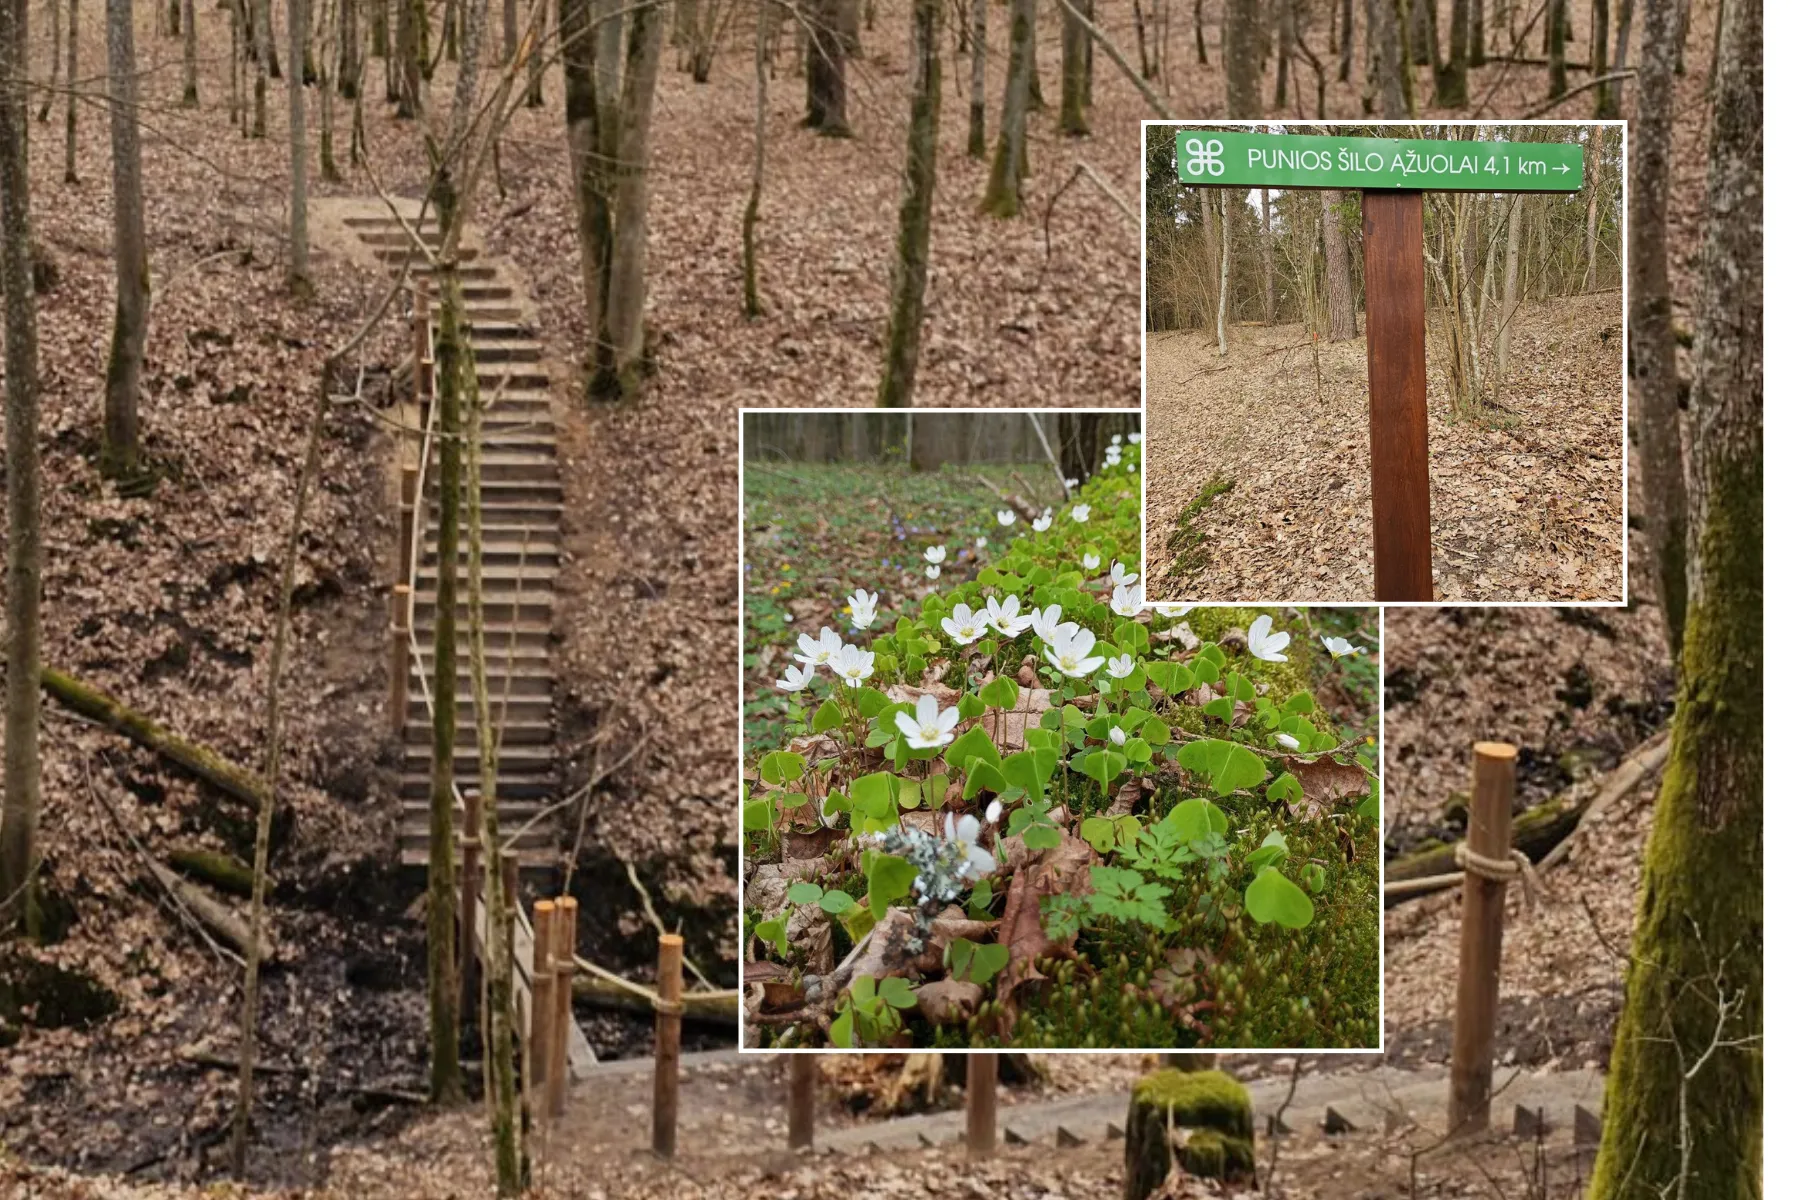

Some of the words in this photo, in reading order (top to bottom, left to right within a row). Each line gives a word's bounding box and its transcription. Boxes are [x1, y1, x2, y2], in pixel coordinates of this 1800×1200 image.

[1248, 148, 1332, 171] PUNIOS
[1338, 147, 1384, 172] ŠILO
[1390, 149, 1478, 177] ĄŽUOLAI
[1484, 155, 1510, 176] 4,1
[1518, 157, 1547, 175] km
